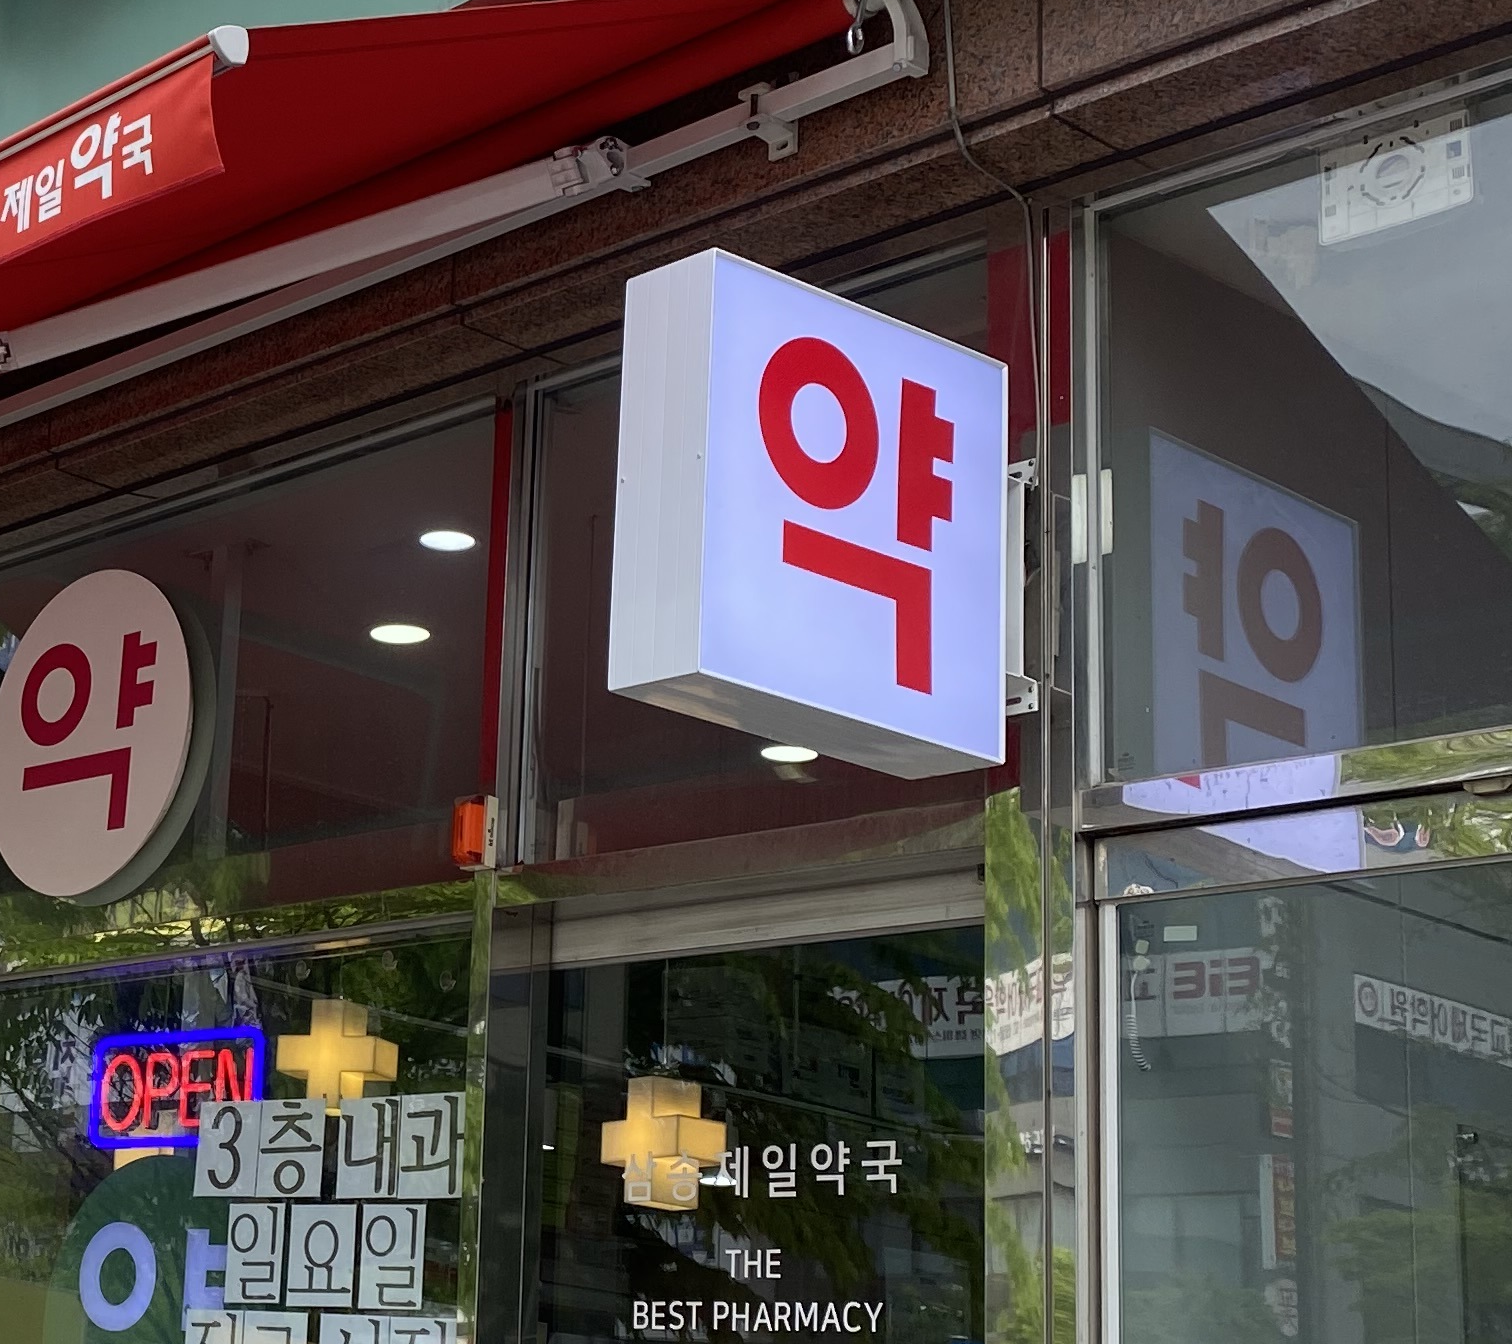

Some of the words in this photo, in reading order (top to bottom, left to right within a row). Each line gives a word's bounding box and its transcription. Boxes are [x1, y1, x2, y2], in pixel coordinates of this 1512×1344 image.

[759, 335, 956, 697] 약
[21, 630, 159, 832] 약
[99, 1047, 256, 1132] OPEN
[207, 1101, 322, 1195] 3층
[341, 1094, 465, 1197] 내과
[622, 1139, 904, 1203] 삼송제일약국
[229, 1205, 419, 1310] 일요일
[725, 1248, 782, 1280] THE
[632, 1300, 702, 1332] BEST
[713, 1301, 884, 1334] PHARMACY
